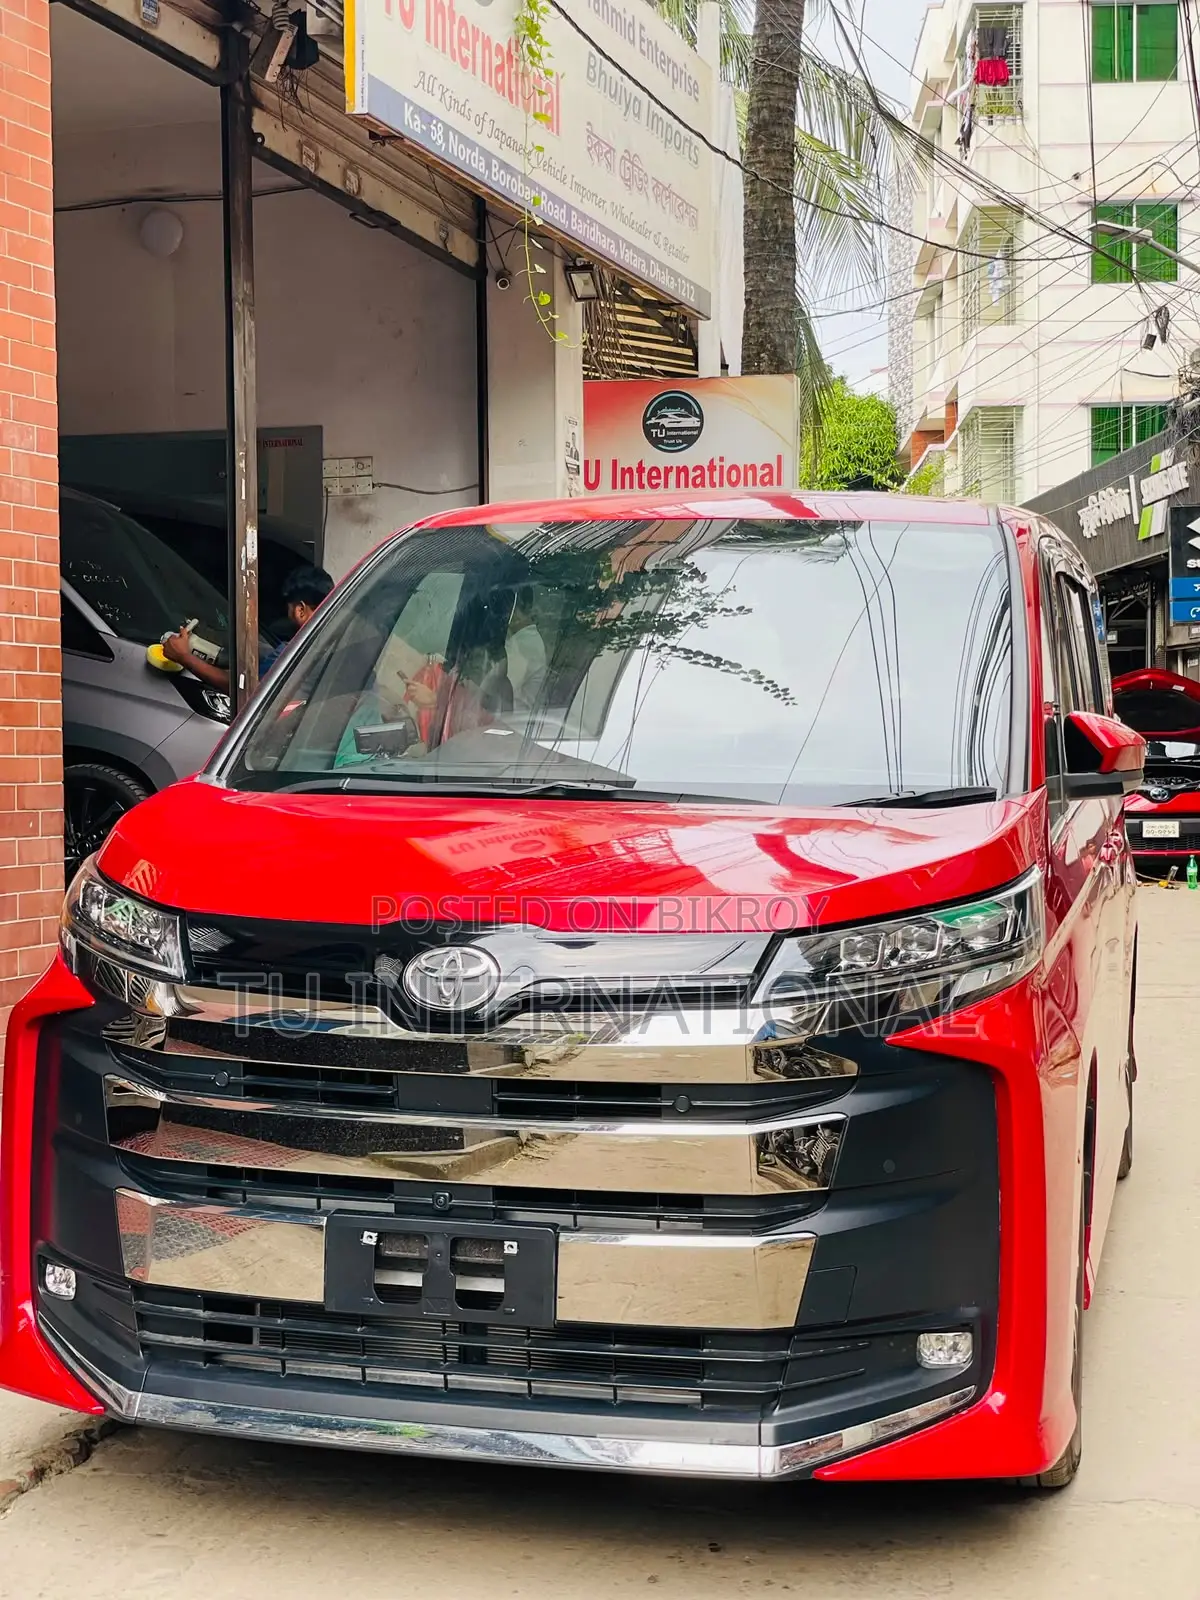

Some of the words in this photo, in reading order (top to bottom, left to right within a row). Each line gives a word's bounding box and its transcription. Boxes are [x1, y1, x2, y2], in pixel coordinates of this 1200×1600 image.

[425, 0, 560, 136] International
[586, 50, 642, 121] Bhuiya
[646, 101, 700, 167] Imports
[588, 0, 636, 47] ahmid
[639, 22, 700, 102] Enterprise
[404, 101, 426, 134] Ka-
[449, 130, 489, 180] Norda,
[541, 190, 569, 229] Road,
[571, 212, 618, 258] Baridhara,
[619, 239, 649, 278] Vatara,
[649, 260, 695, 302] Dhaka-1212
[414, 70, 436, 97] All
[438, 84, 471, 122] Kinds
[474, 112, 487, 135] of
[487, 119, 532, 162] Japanese
[534, 150, 568, 186] Vehicle
[610, 201, 652, 241] Wholesaler
[611, 454, 783, 491] International
[651, 429, 665, 438] TU
